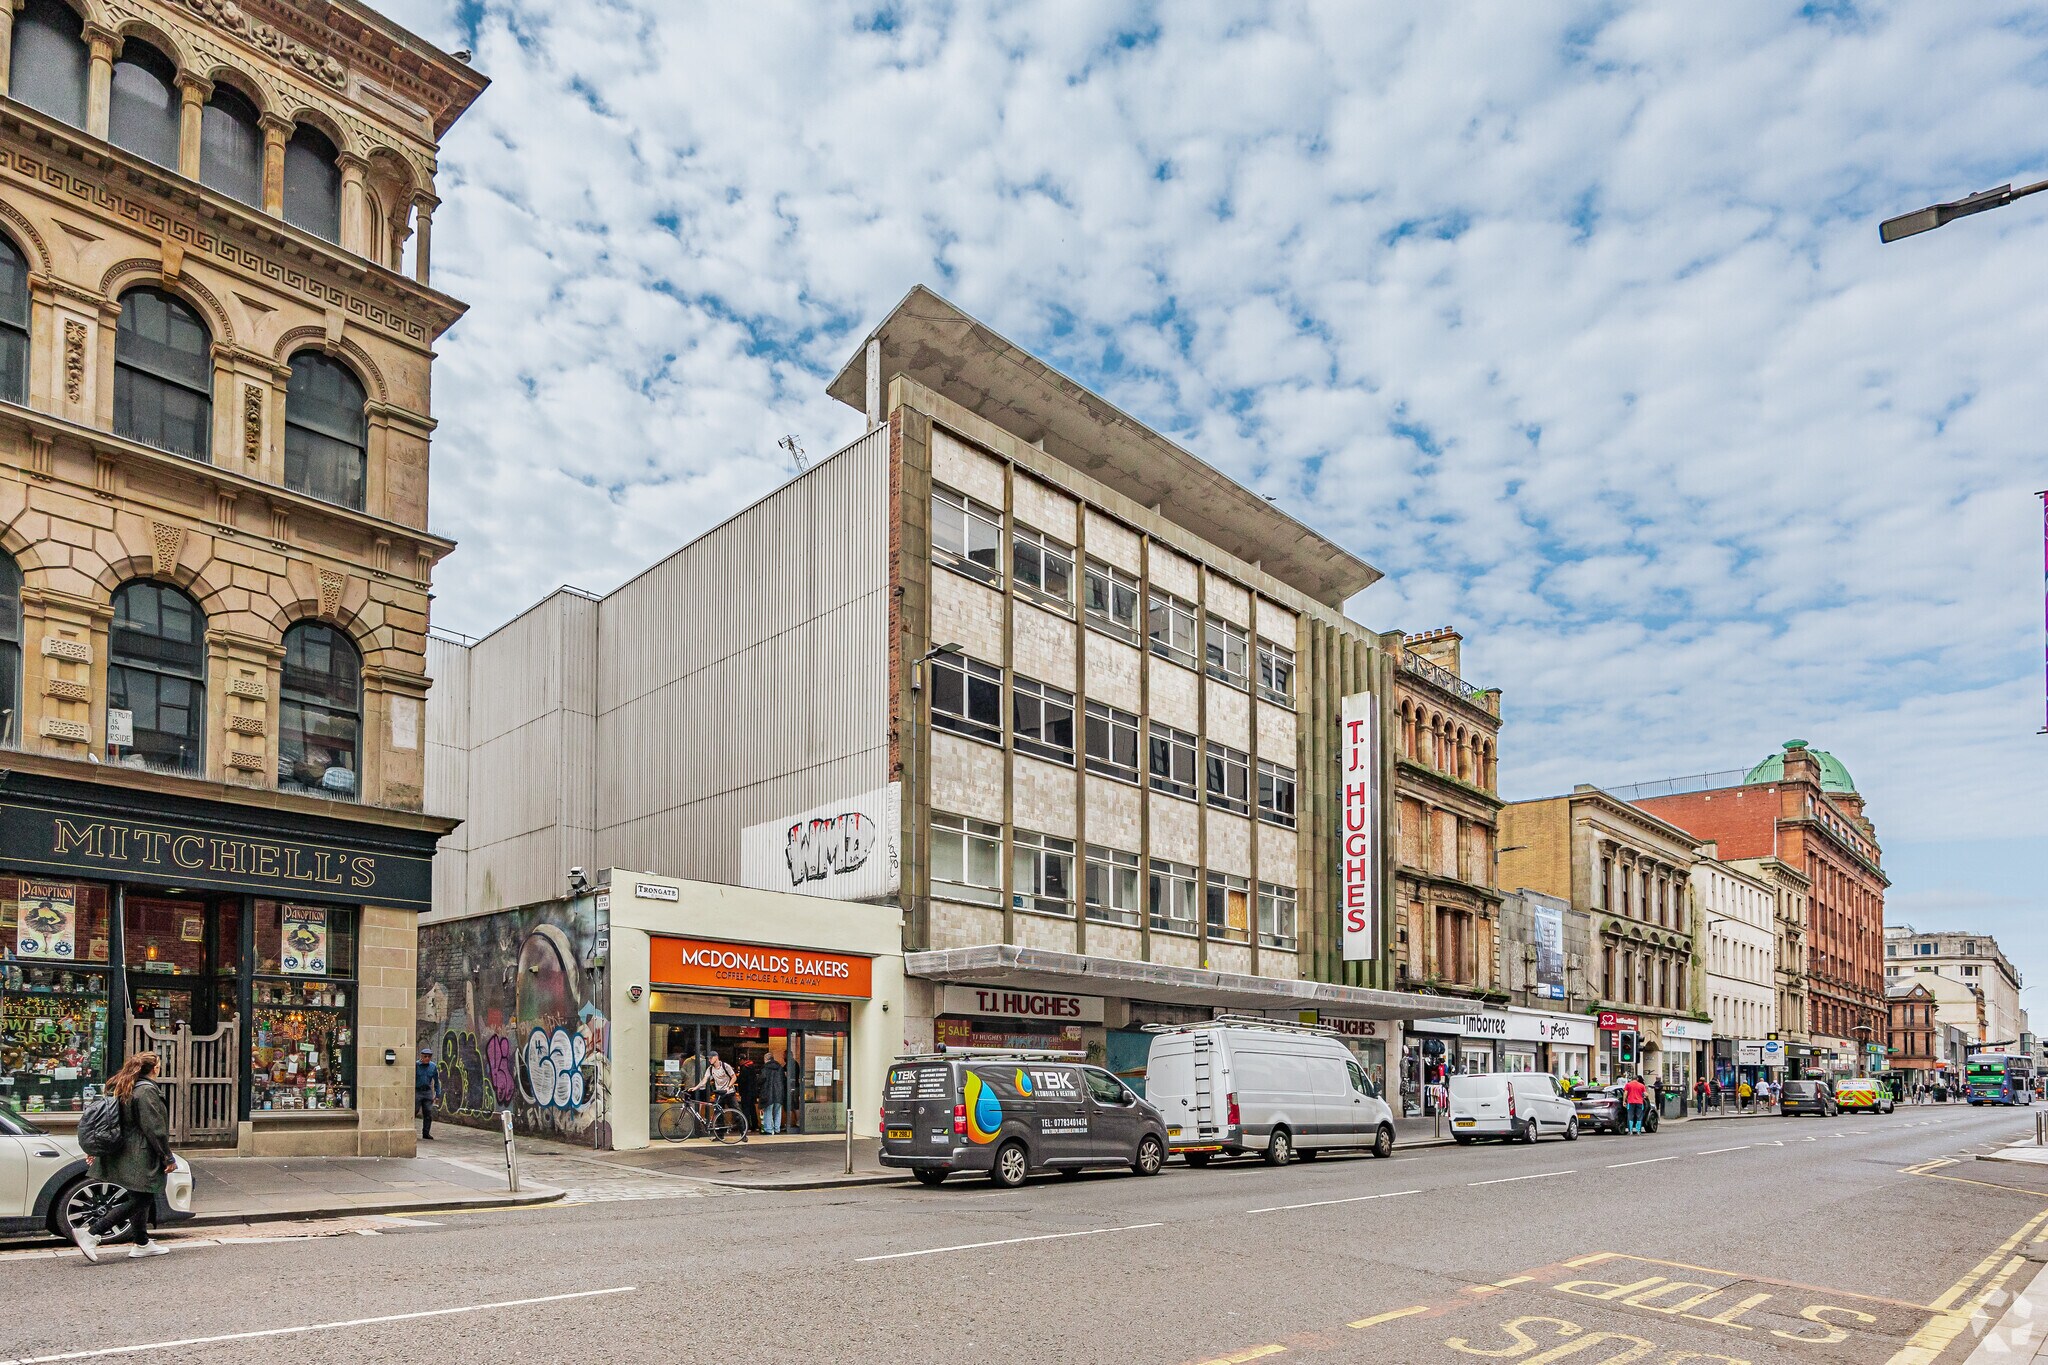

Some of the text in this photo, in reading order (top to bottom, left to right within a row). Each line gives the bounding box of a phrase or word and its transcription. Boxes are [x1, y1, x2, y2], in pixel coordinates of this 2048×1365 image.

[54, 818, 377, 888] MITCHELL'S
[1346, 782, 1366, 933] HUGHES
[22, 880, 72, 898] PANOPTICON
[638, 885, 676, 896] TRONGATE
[682, 948, 849, 978] MCDONALDS BAKERS
[715, 970, 821, 987] COFFEE HOUSE & TAKE AWAY
[1003, 993, 1081, 1017] HUGHES
[14, 1031, 74, 1044] SHOP
[938, 1022, 946, 1043] ALE
[948, 1026, 970, 1036] SALE
[897, 1070, 917, 1080] TBK
[1030, 1072, 1074, 1090] TBK
[1042, 1118, 1052, 1128] TEL:
[1553, 1276, 1877, 1343] STOP
